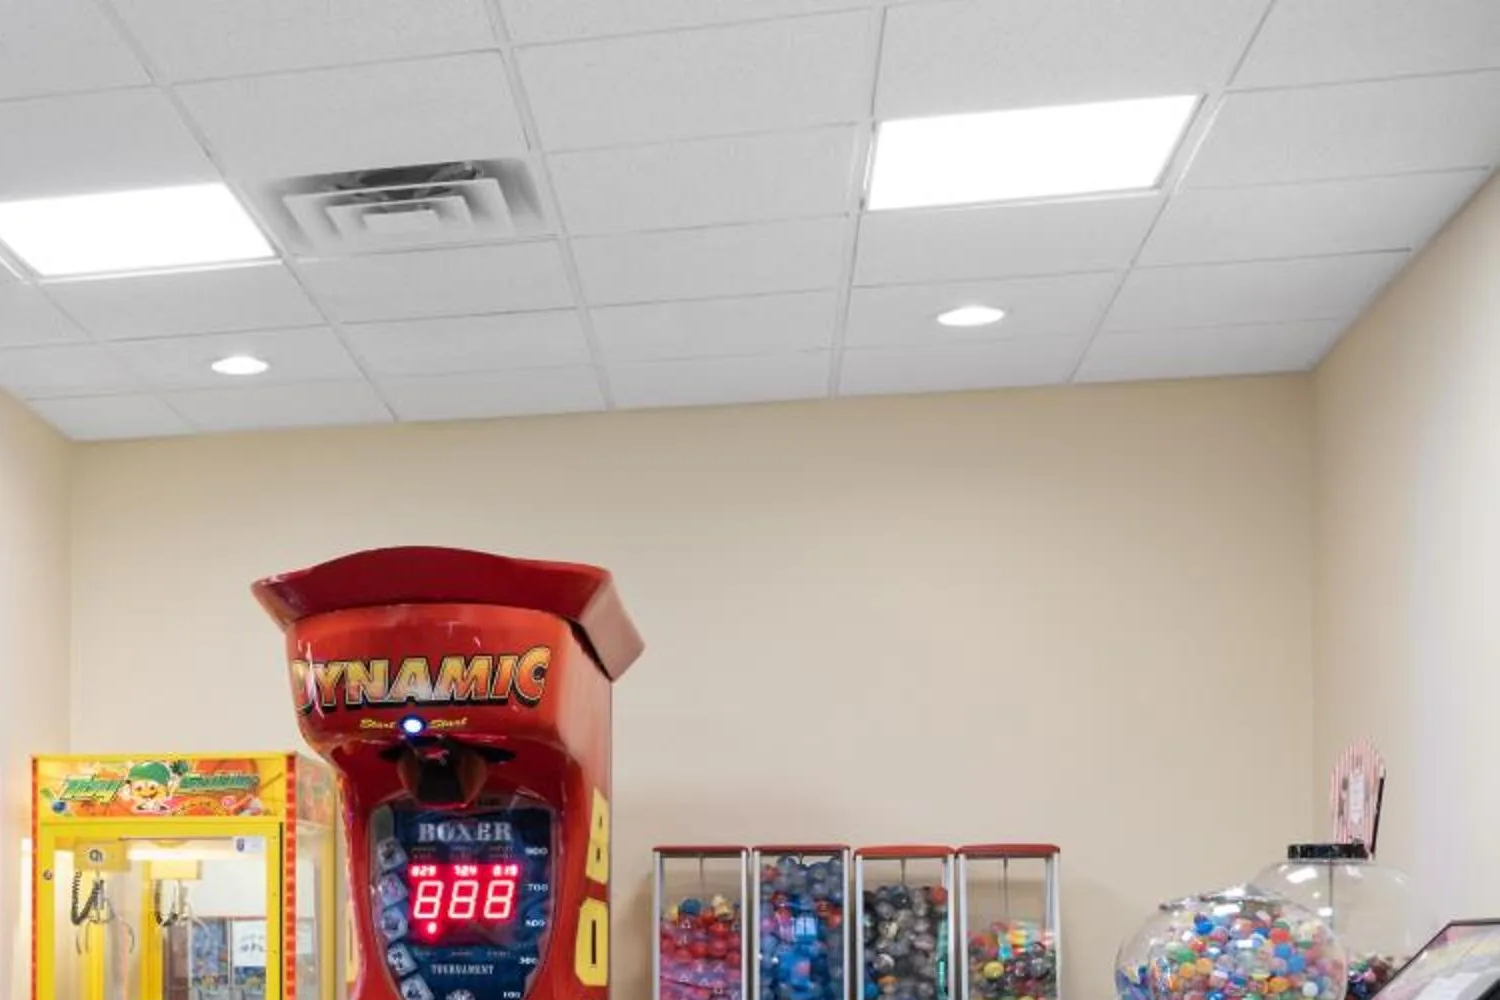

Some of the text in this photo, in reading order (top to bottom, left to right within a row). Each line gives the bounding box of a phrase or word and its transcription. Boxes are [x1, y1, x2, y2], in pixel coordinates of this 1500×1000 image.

[418, 821, 514, 842] BOXER
[412, 879, 516, 919] 888
[430, 963, 495, 976] TOURNAMENT
